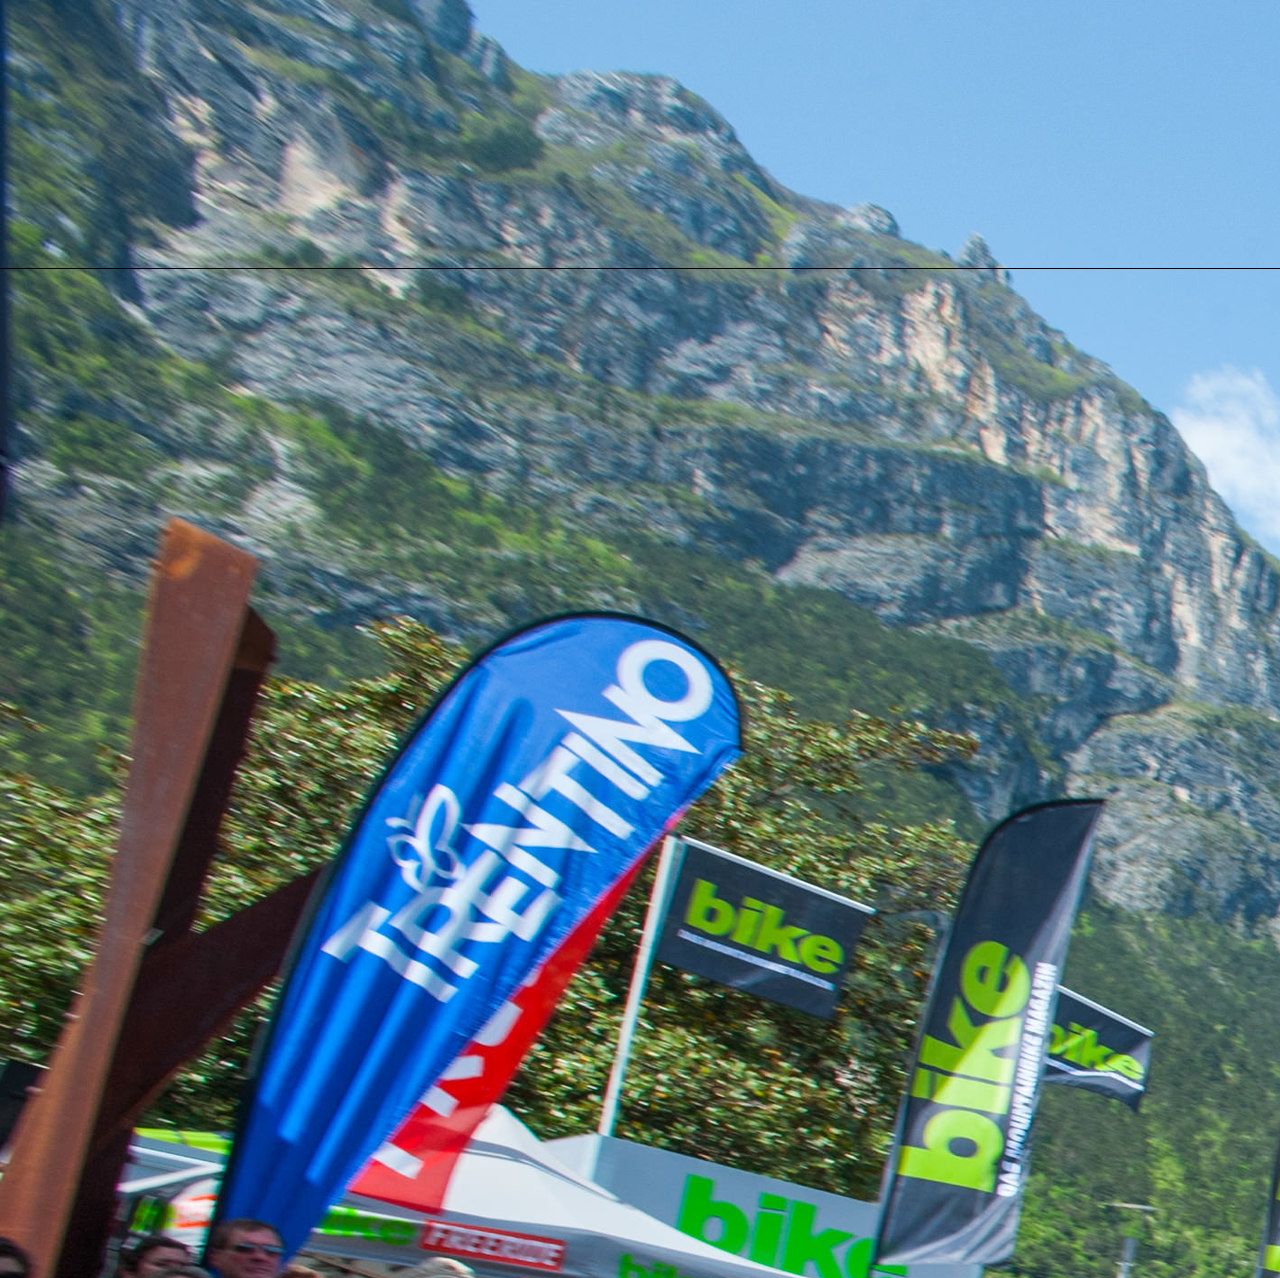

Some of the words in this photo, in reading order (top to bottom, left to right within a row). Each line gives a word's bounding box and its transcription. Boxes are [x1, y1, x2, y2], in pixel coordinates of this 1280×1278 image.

[321, 638, 714, 1003] TRENTINO
[685, 879, 846, 978] bike
[898, 941, 1031, 1193] bike
[427, 1225, 563, 1269] FREERIDE
